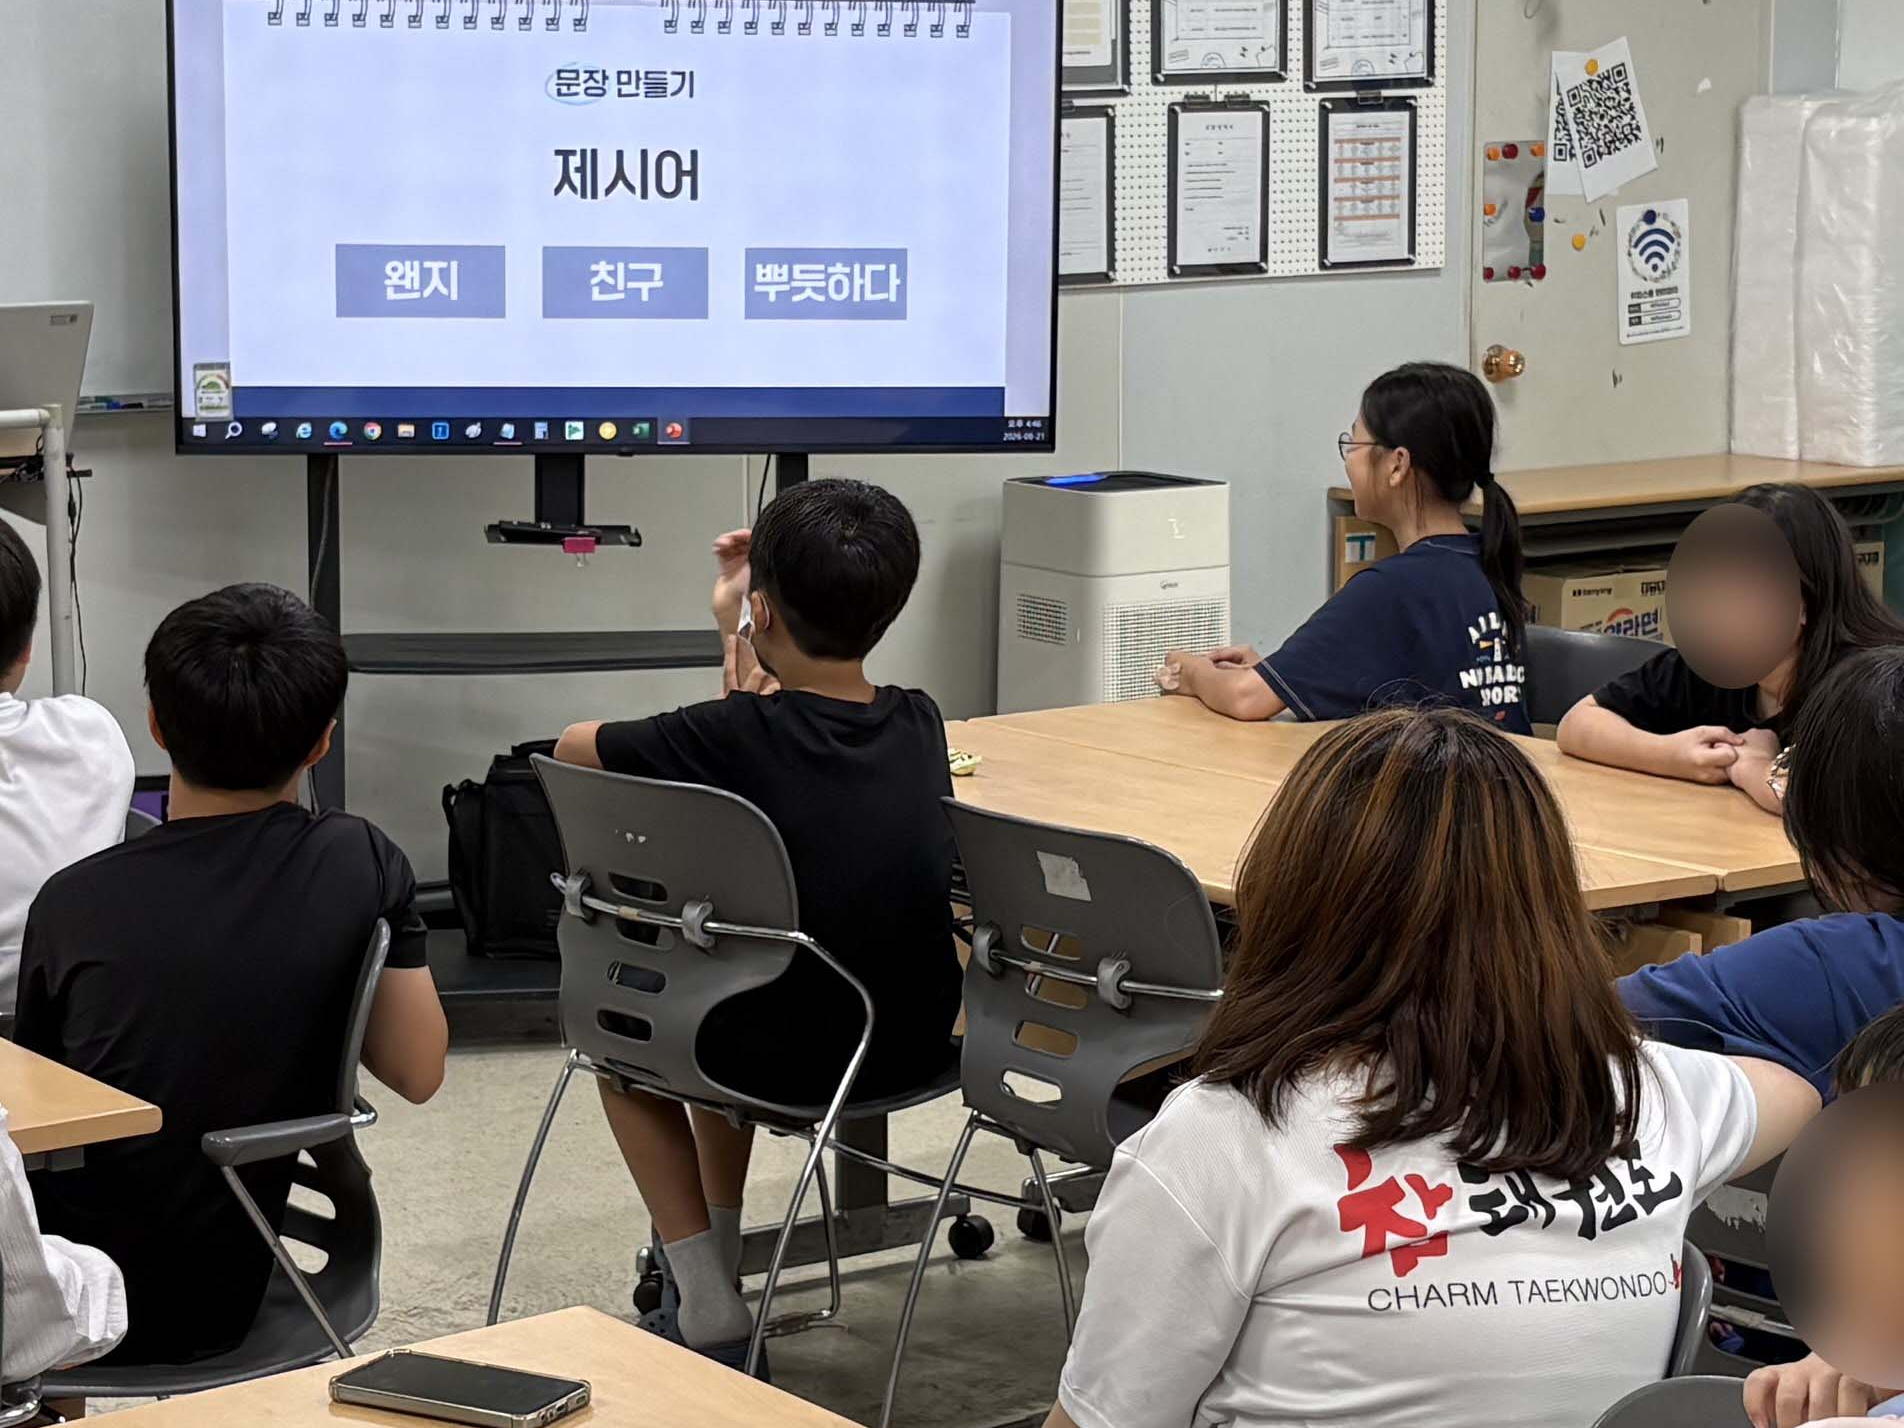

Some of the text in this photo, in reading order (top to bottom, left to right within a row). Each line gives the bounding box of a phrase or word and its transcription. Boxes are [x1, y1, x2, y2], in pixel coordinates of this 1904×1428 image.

[556, 67, 696, 101] 문장 만들기
[553, 148, 699, 203] 제시어
[383, 260, 458, 302] 왠지
[589, 261, 664, 302] 친구
[755, 262, 901, 302] 뿌듯하다
[1368, 1271, 1666, 1312] CHARM TAEKWONDO
